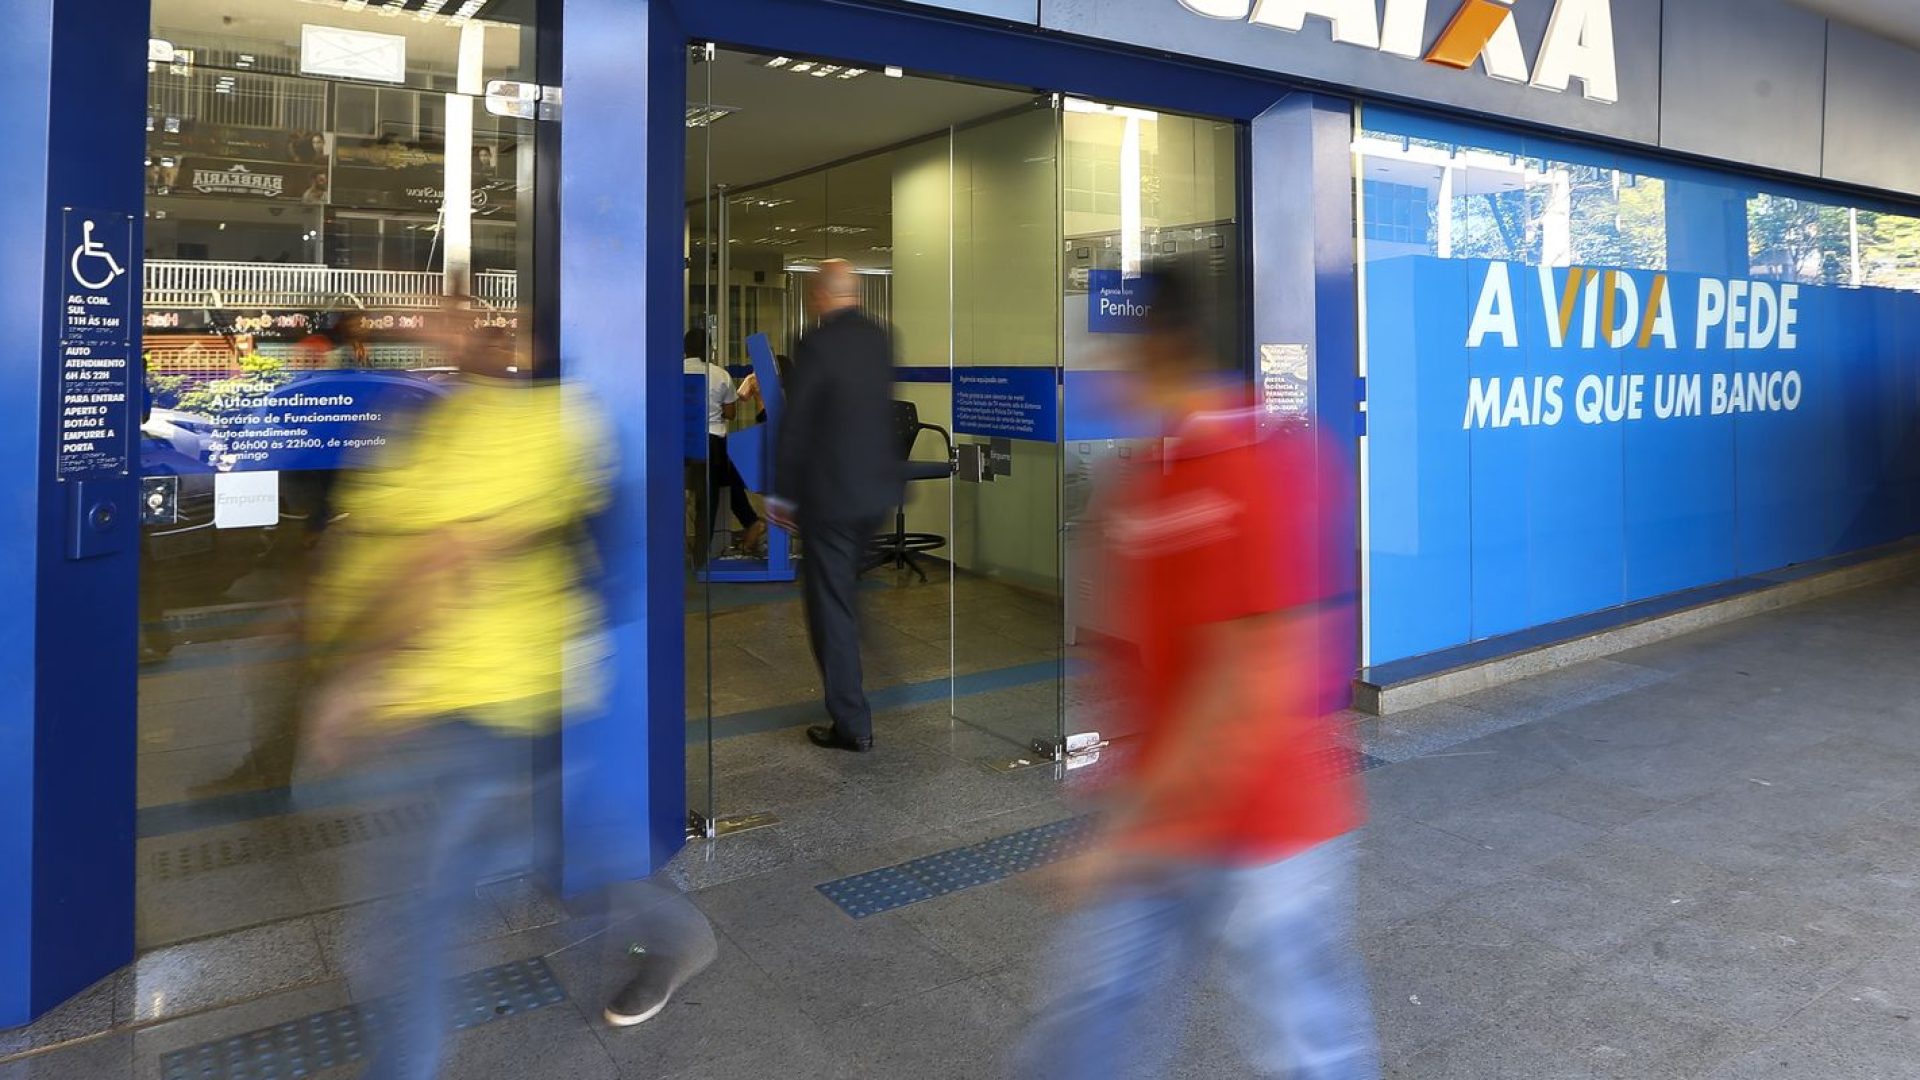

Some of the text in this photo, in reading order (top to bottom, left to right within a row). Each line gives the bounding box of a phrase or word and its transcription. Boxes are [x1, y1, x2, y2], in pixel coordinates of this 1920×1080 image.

[1177, 0, 1617, 104] IXA
[67, 295, 111, 306] AG. COM.
[1465, 262, 1798, 349] A VIDA PEDE
[67, 305, 85, 315] SUL
[1101, 298, 1151, 317] Penhor
[68, 316, 87, 325] 11H
[102, 318, 120, 327] 16H
[65, 347, 91, 355] AUTO
[65, 359, 126, 368] ATENDIMENTO
[65, 371, 78, 380] 6H
[92, 371, 110, 380] 22H
[210, 381, 275, 394] Entrada
[64, 394, 125, 404] PARA ENTRAR
[211, 393, 353, 408] Autoatendimento
[1463, 370, 1801, 430] MAIS QUE UM BANCO
[64, 406, 107, 416] APERTE O
[64, 416, 105, 429] BOTÃO E
[210, 412, 382, 425] Horário de Funcionamento:
[64, 429, 115, 441] EMPURRE A
[210, 428, 308, 441] Autoatendimento
[63, 442, 94, 453] PORTA
[232, 439, 268, 450] 06h00
[286, 438, 324, 450] 22h00,
[327, 437, 341, 448] de
[343, 436, 386, 449] segunda
[218, 493, 274, 507] Empurre
